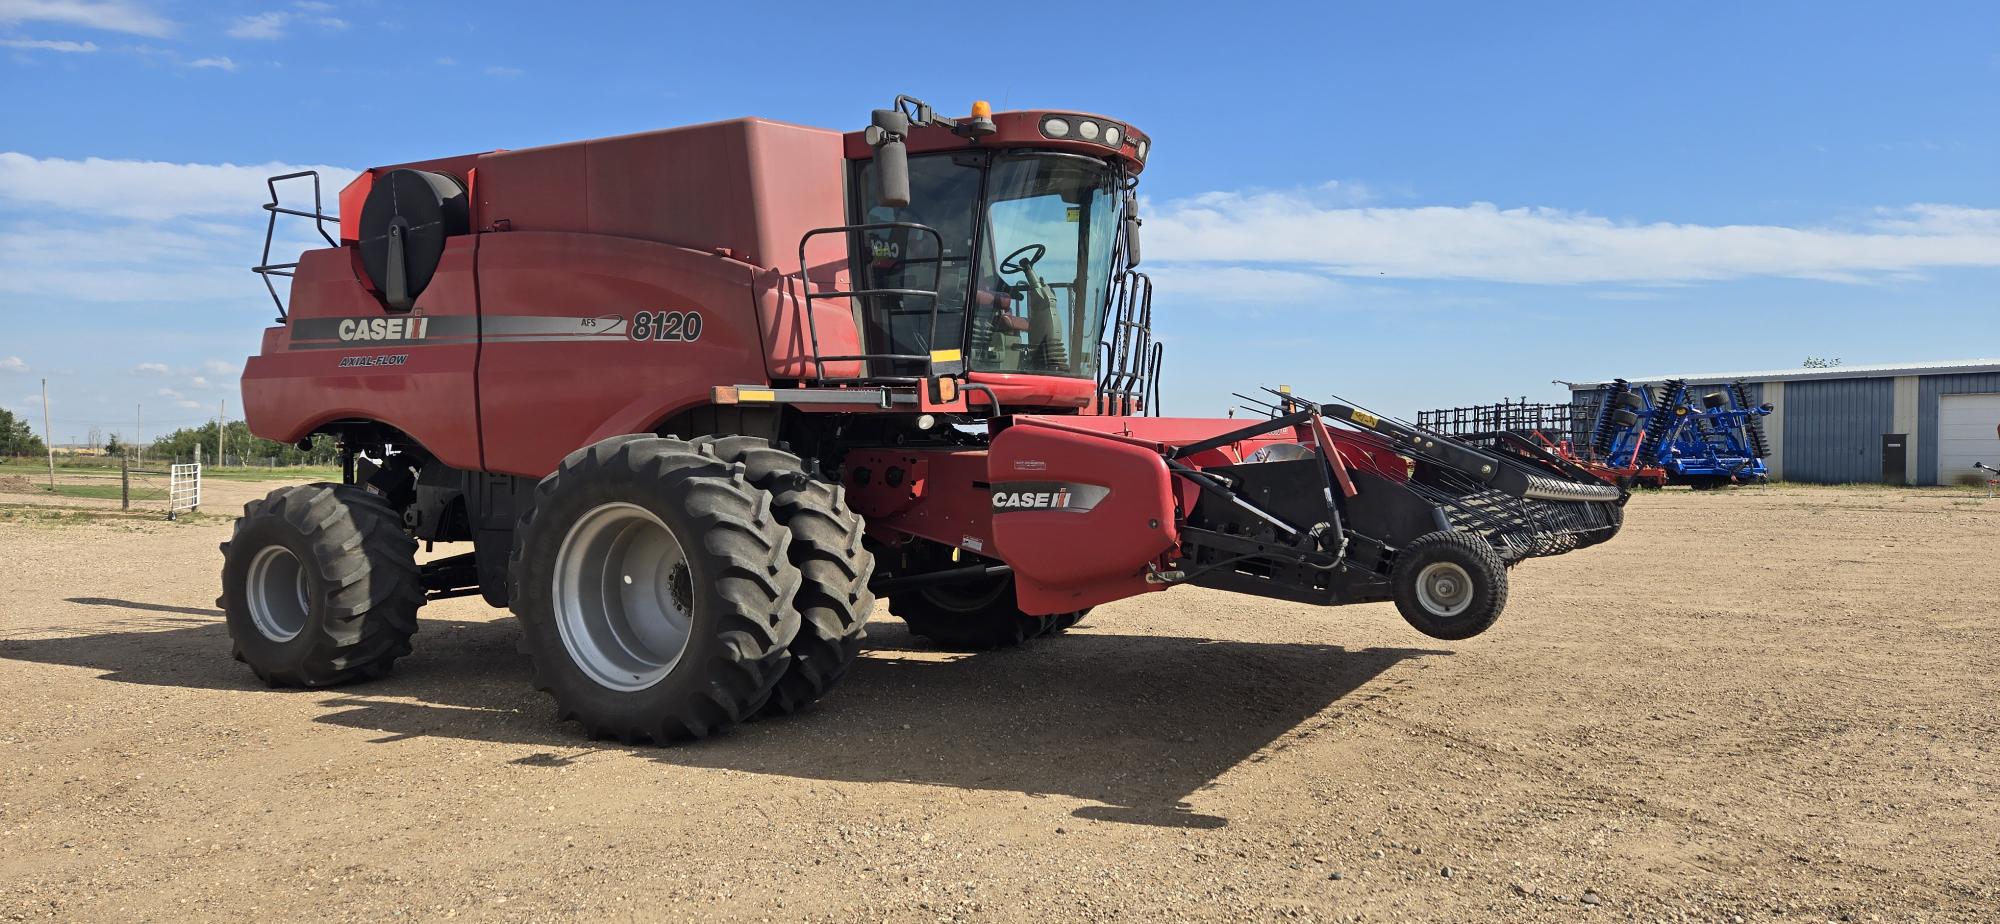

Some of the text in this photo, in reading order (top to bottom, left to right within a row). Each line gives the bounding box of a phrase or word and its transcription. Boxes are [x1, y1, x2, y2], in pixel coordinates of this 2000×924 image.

[339, 318, 403, 341] CASE
[581, 318, 596, 327] AFS
[631, 310, 703, 343] 8120
[338, 354, 408, 368] AXIAL-FLOW
[992, 492, 1050, 508] CASE
